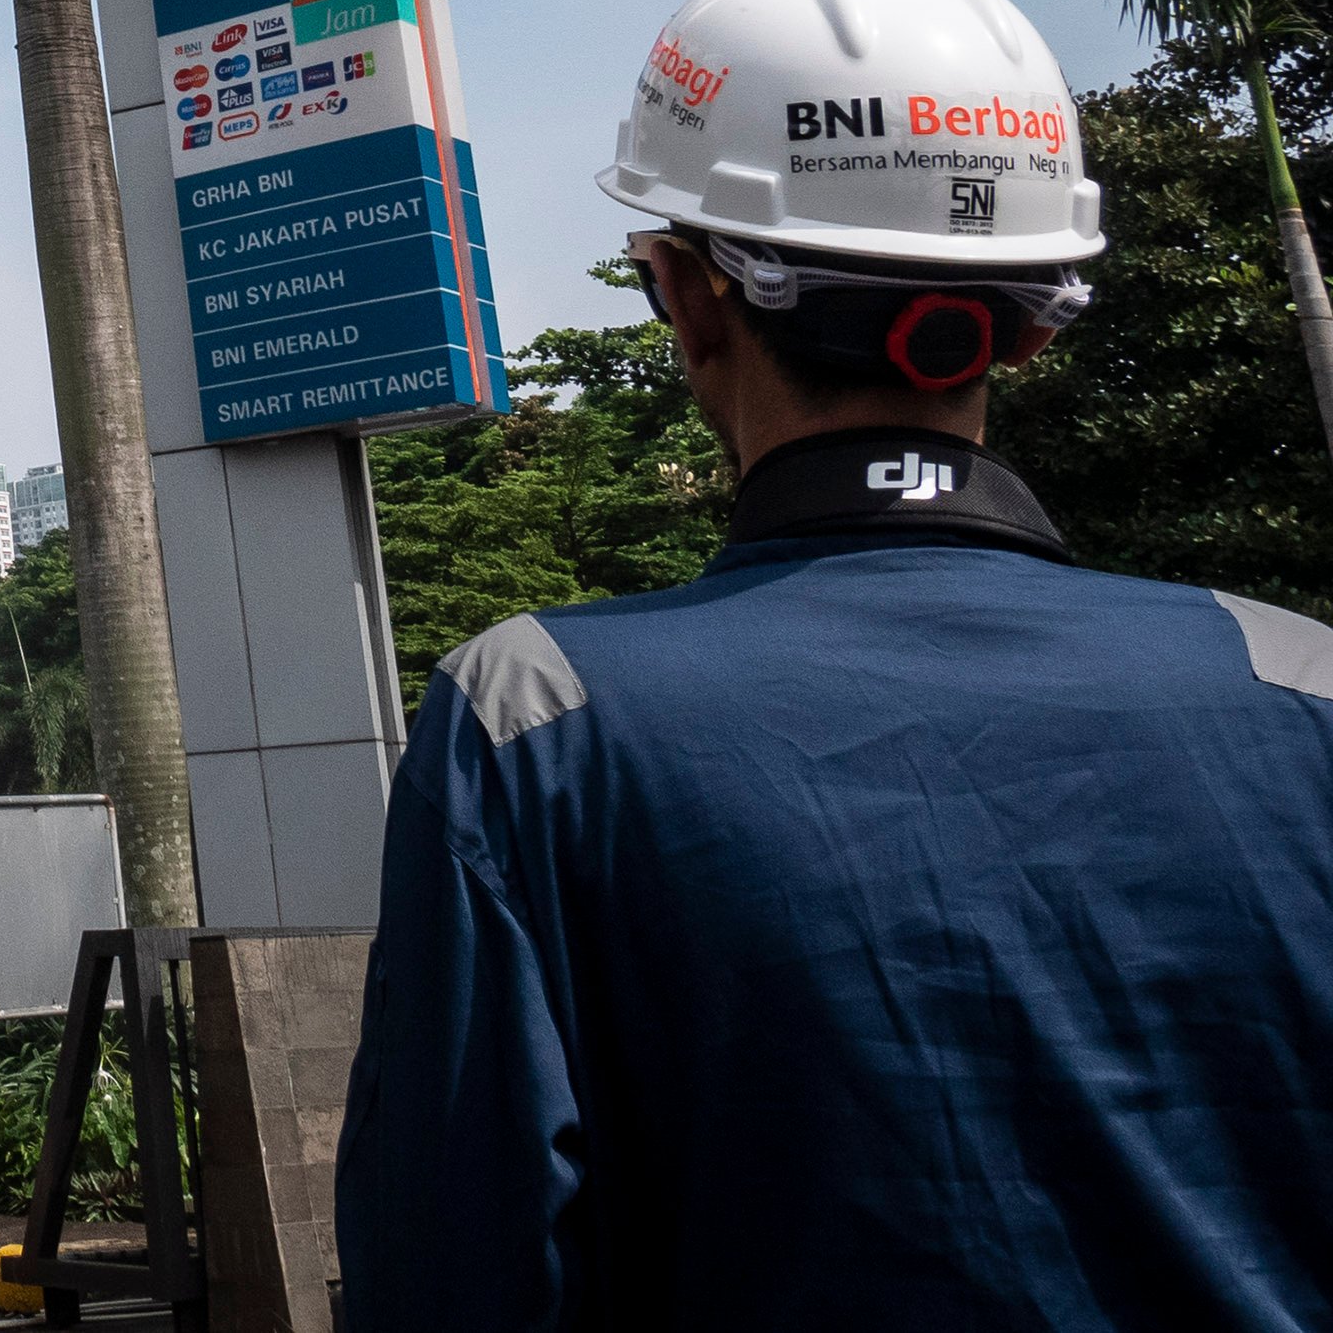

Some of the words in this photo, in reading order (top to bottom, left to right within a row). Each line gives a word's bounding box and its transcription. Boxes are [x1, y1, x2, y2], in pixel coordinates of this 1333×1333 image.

[258, 17, 285, 32] VISA
[320, 4, 375, 36] Jam
[215, 28, 243, 45] Link
[184, 41, 202, 53] BNI
[262, 46, 283, 57] VISA
[219, 61, 246, 74] Cirrus
[261, 59, 288, 71] Electron
[229, 93, 252, 108] PLUS
[302, 97, 339, 115] EXK
[224, 119, 254, 133] MEPS
[786, 97, 885, 141] BNI
[907, 95, 1067, 154] Berbagi
[790, 152, 888, 173] Bersama
[192, 179, 251, 208] GRHA
[258, 169, 294, 194] BNI
[950, 182, 995, 216] SNI
[198, 239, 227, 261] KC
[234, 216, 337, 254] JAKARTA
[345, 197, 423, 230] PUSAT
[205, 290, 239, 314] BNI
[247, 269, 346, 305] SYARIAH
[211, 346, 246, 368] BNI
[253, 325, 359, 360] EMERALD
[218, 393, 293, 423] SMART
[302, 367, 450, 409] REMITTANCE
